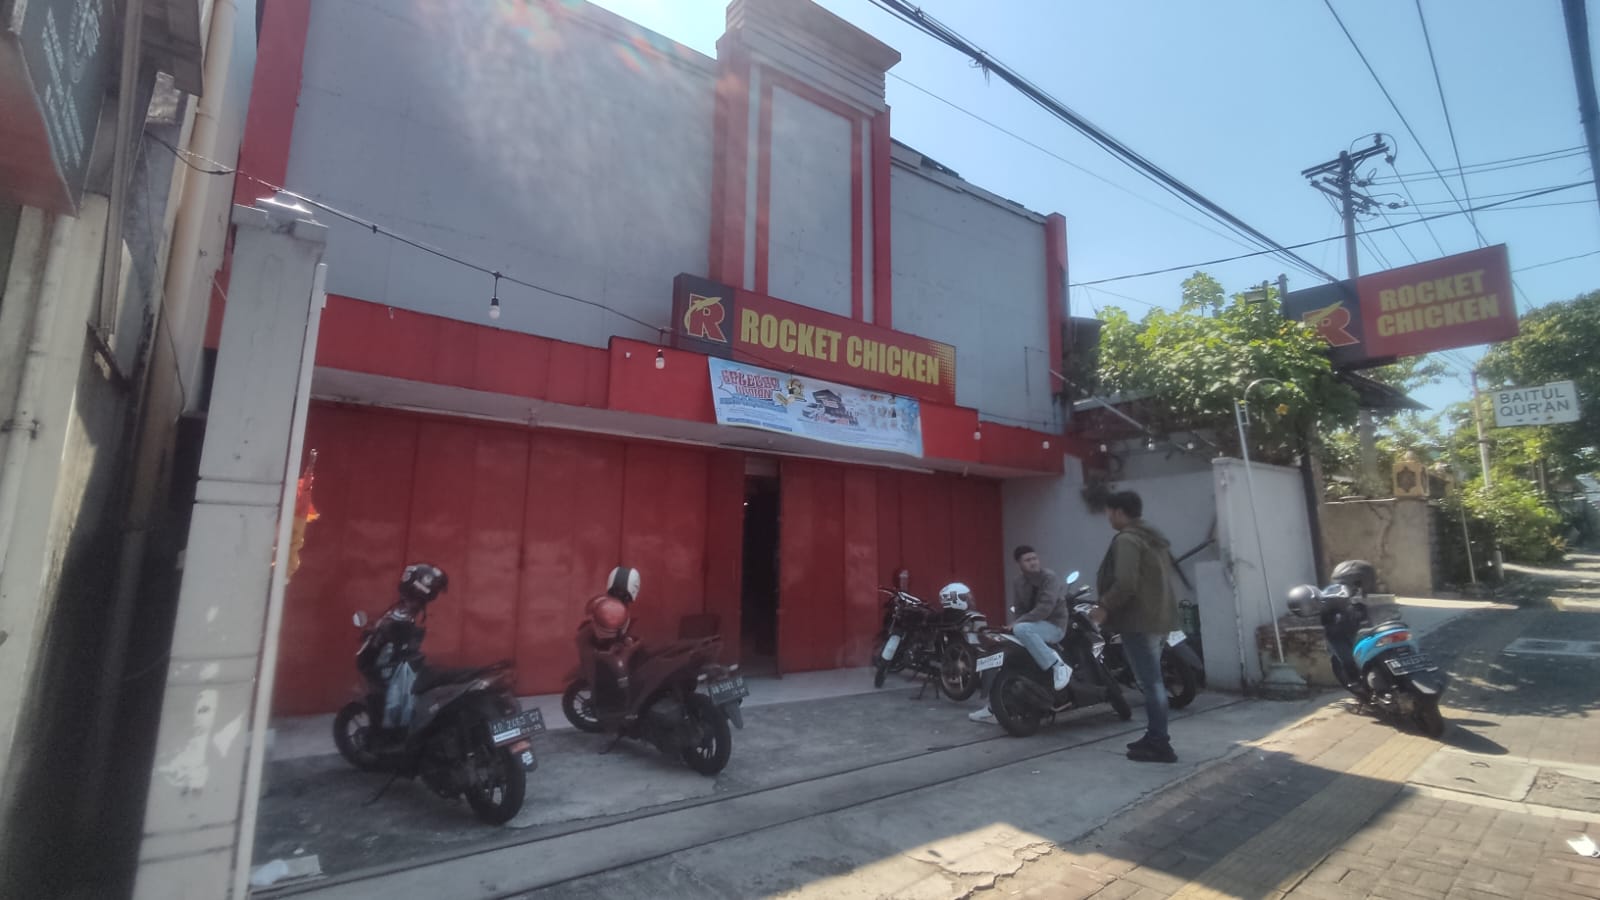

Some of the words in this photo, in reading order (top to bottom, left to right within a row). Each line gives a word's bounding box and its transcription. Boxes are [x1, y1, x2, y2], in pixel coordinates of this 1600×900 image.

[1379, 269, 1485, 312] ROCKET
[1376, 293, 1500, 336] CHICKEN
[741, 308, 842, 362] ROCKET
[846, 335, 940, 385] CHICKEN
[1500, 387, 1566, 404] BAITUL
[1500, 399, 1569, 416] QUR'AN
